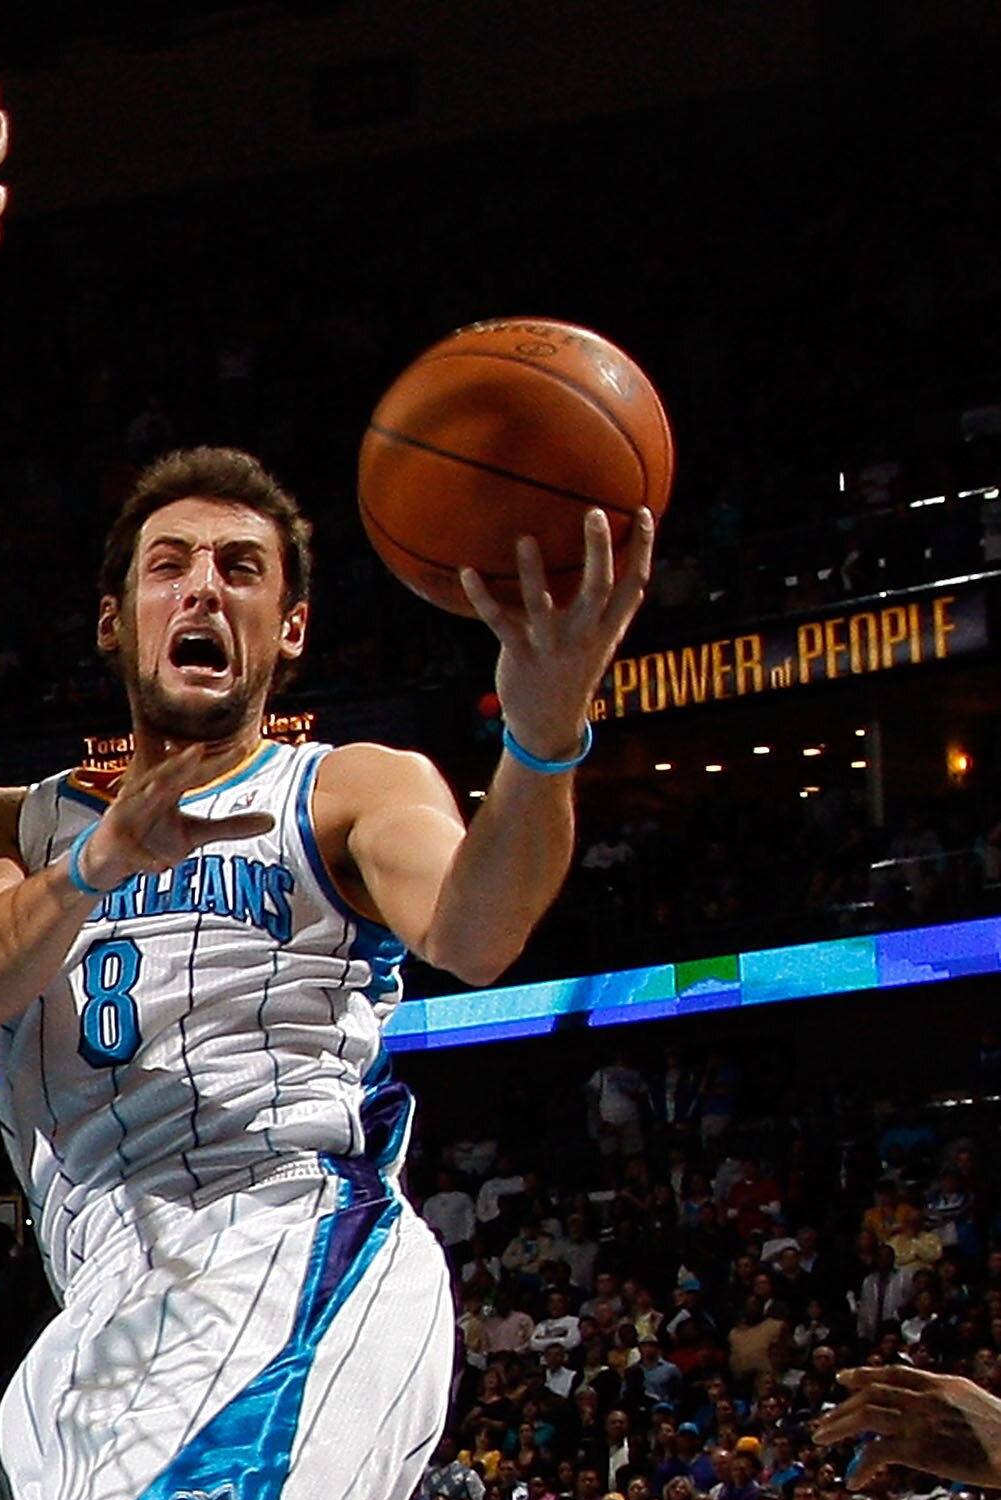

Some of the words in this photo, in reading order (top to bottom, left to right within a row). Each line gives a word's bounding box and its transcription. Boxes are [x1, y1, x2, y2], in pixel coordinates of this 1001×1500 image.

[614, 634, 763, 718] POWER
[799, 596, 956, 684] PEOPLE
[86, 855, 294, 944] RLEANS
[78, 937, 143, 1068] 8
